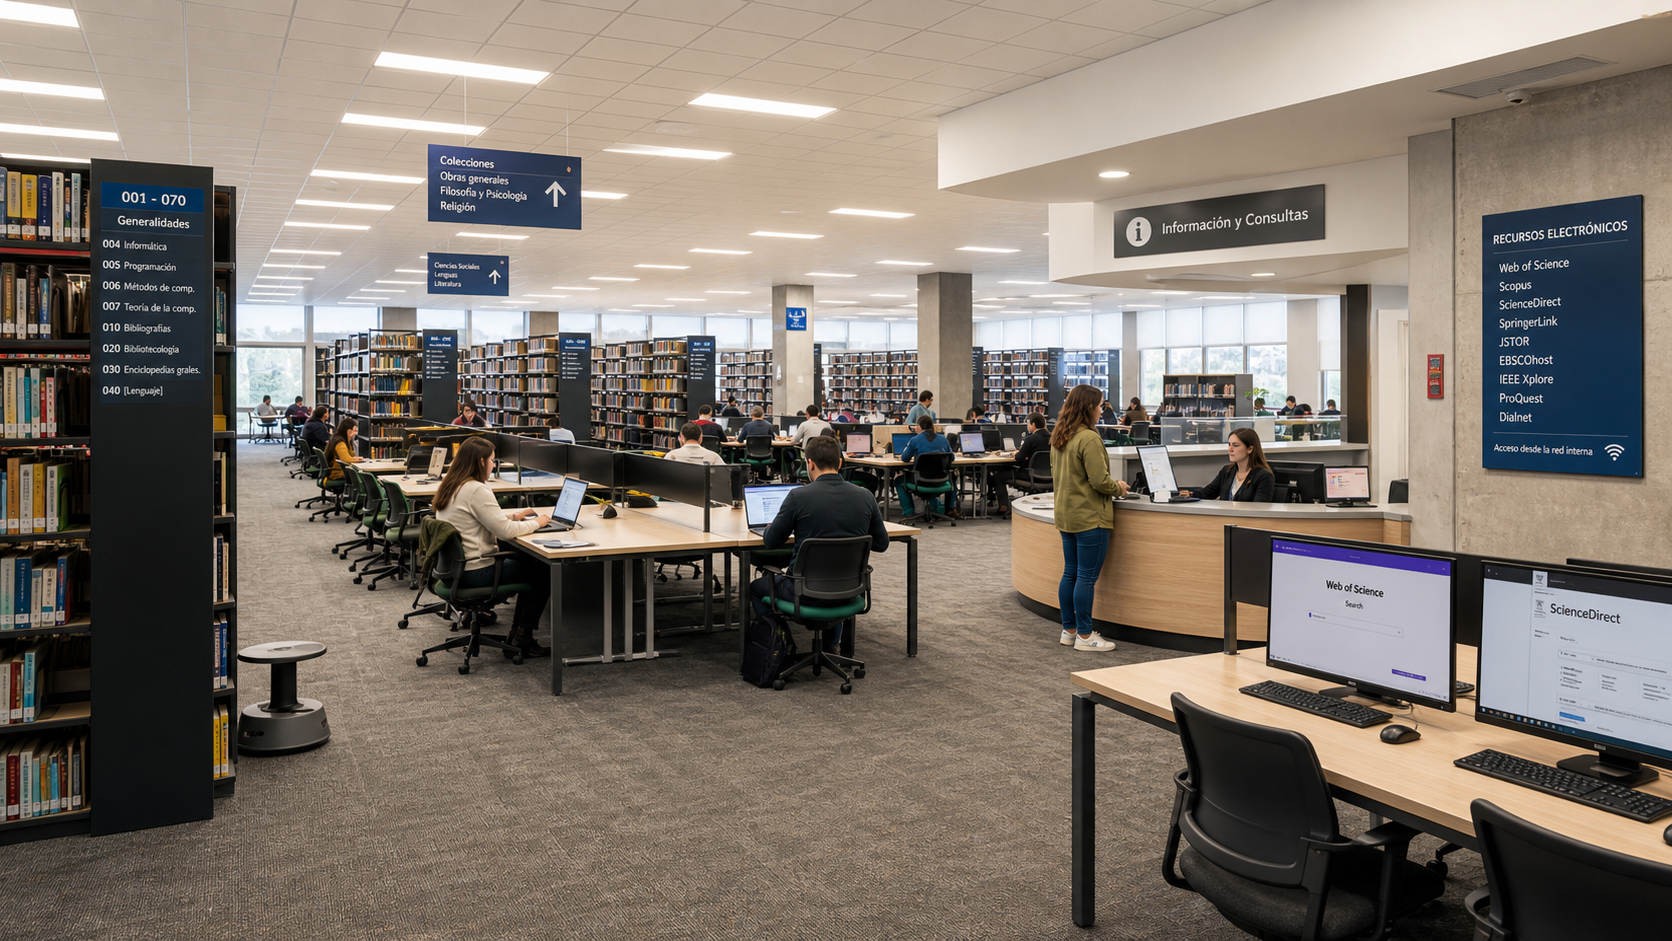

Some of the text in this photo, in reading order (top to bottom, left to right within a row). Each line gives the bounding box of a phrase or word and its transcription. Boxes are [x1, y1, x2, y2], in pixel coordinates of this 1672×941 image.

[440, 155, 495, 169] Colecciones
[440, 171, 509, 186] Obras generales
[122, 191, 147, 204] 001
[161, 193, 187, 207] 070
[479, 190, 484, 200] y
[440, 201, 476, 213] Religión
[117, 215, 190, 229] Generalidades
[1162, 208, 1309, 235] Información y Consultas
[1493, 220, 1628, 245] RECURSOS ELECTRÓNICOS
[102, 239, 168, 251] 004 Informática
[102, 260, 177, 273] 005 Programación
[1499, 258, 1570, 274] Web of Science
[102, 280, 195, 295] 006 Métodos de comp.
[1499, 281, 1532, 293] Scopus
[102, 301, 121, 311] 007
[150, 303, 161, 312] de
[163, 303, 171, 312] la
[172, 305, 197, 315] comp.
[1499, 296, 1562, 311] ScienceDirect
[102, 322, 121, 332] 010
[1499, 315, 1558, 331] SpringerLink
[102, 343, 121, 353] 020
[1499, 336, 1530, 348] JSTOR
[1499, 354, 1554, 366] EBSCOhost
[102, 364, 121, 374] 030
[176, 365, 201, 376] grales.
[1499, 373, 1554, 387] IEEE Xplore
[102, 385, 121, 395] 040
[1499, 392, 1544, 405] ProQuest
[1499, 411, 1533, 423] Dialnet
[1493, 443, 1593, 457] Acceso desde la red interna
[1325, 579, 1385, 598] Web of Science
[1344, 599, 1364, 611] Search
[1549, 602, 1621, 625] ScienceDirect
